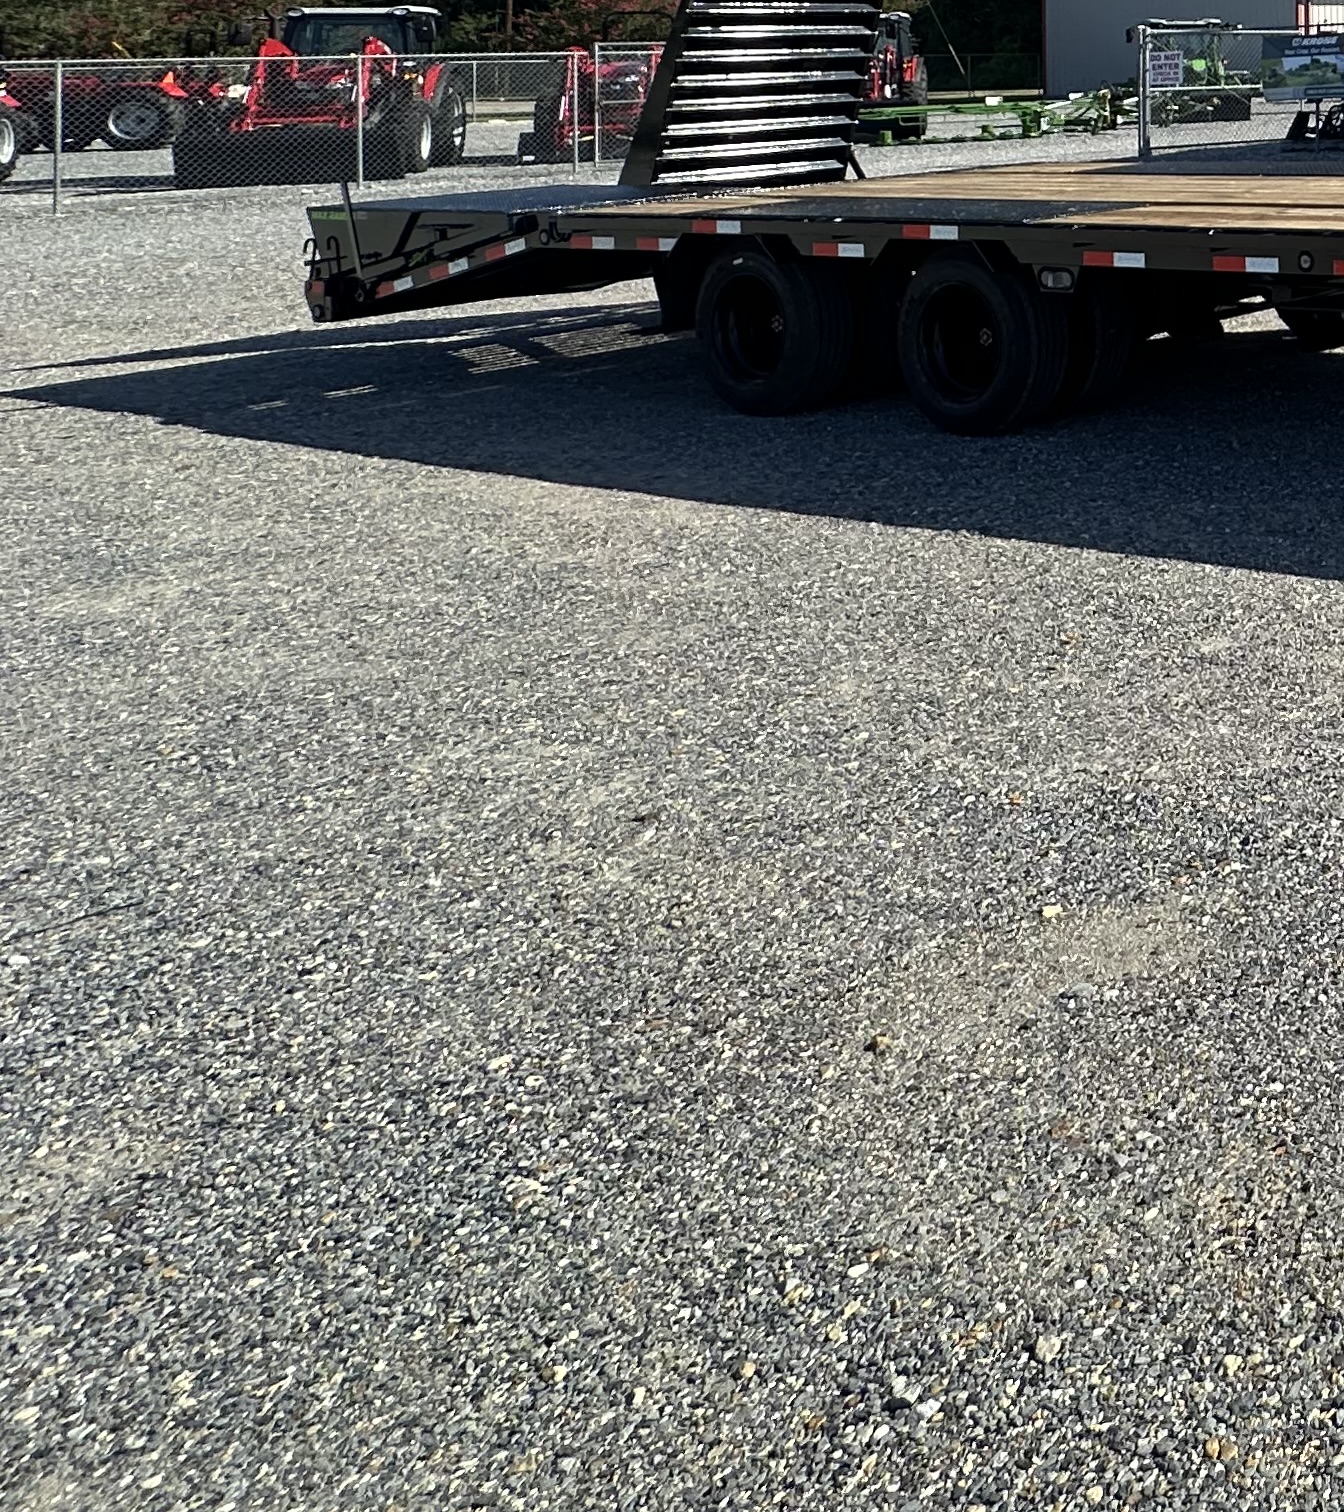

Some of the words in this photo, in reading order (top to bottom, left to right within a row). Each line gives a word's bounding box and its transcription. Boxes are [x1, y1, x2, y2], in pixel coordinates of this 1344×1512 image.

[1149, 54, 1161, 62] DO
[1163, 53, 1180, 61] NOT
[1151, 62, 1180, 71] ENTER
